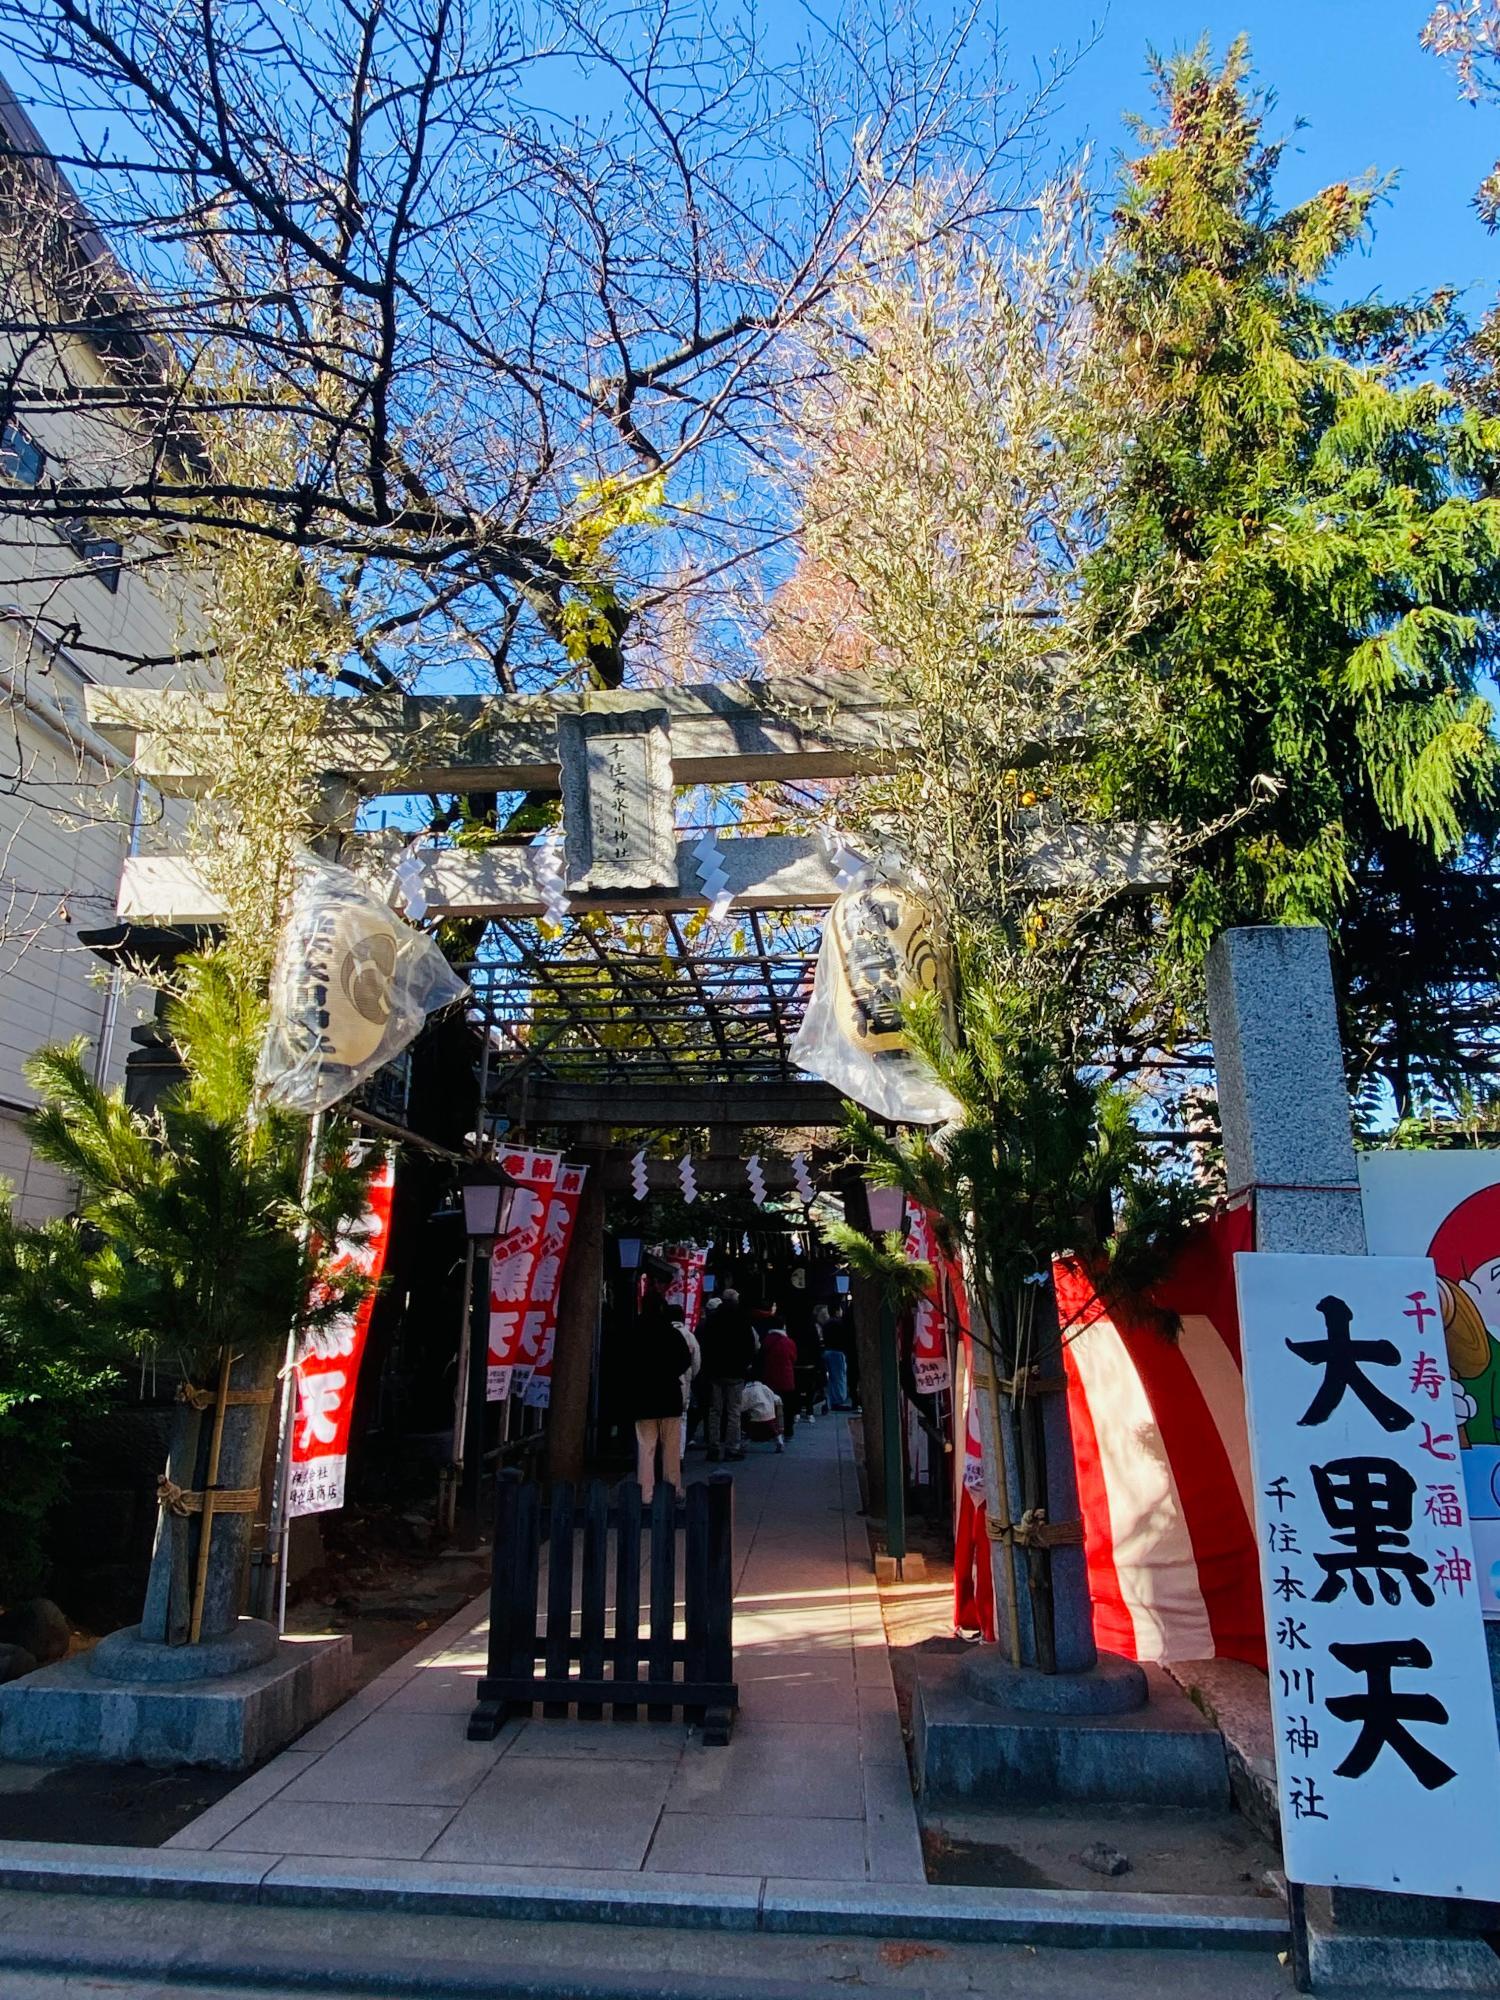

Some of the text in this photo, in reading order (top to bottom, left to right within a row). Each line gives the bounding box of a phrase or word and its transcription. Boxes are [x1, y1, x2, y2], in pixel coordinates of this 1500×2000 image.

[607, 743, 631, 858] 千住本氷川神社
[502, 1154, 554, 1180] 奉納
[1285, 1294, 1458, 1790] 大黒天
[1403, 1290, 1473, 1598] 千寿七福神
[1265, 1475, 1329, 1820] 千住本氷川神社
